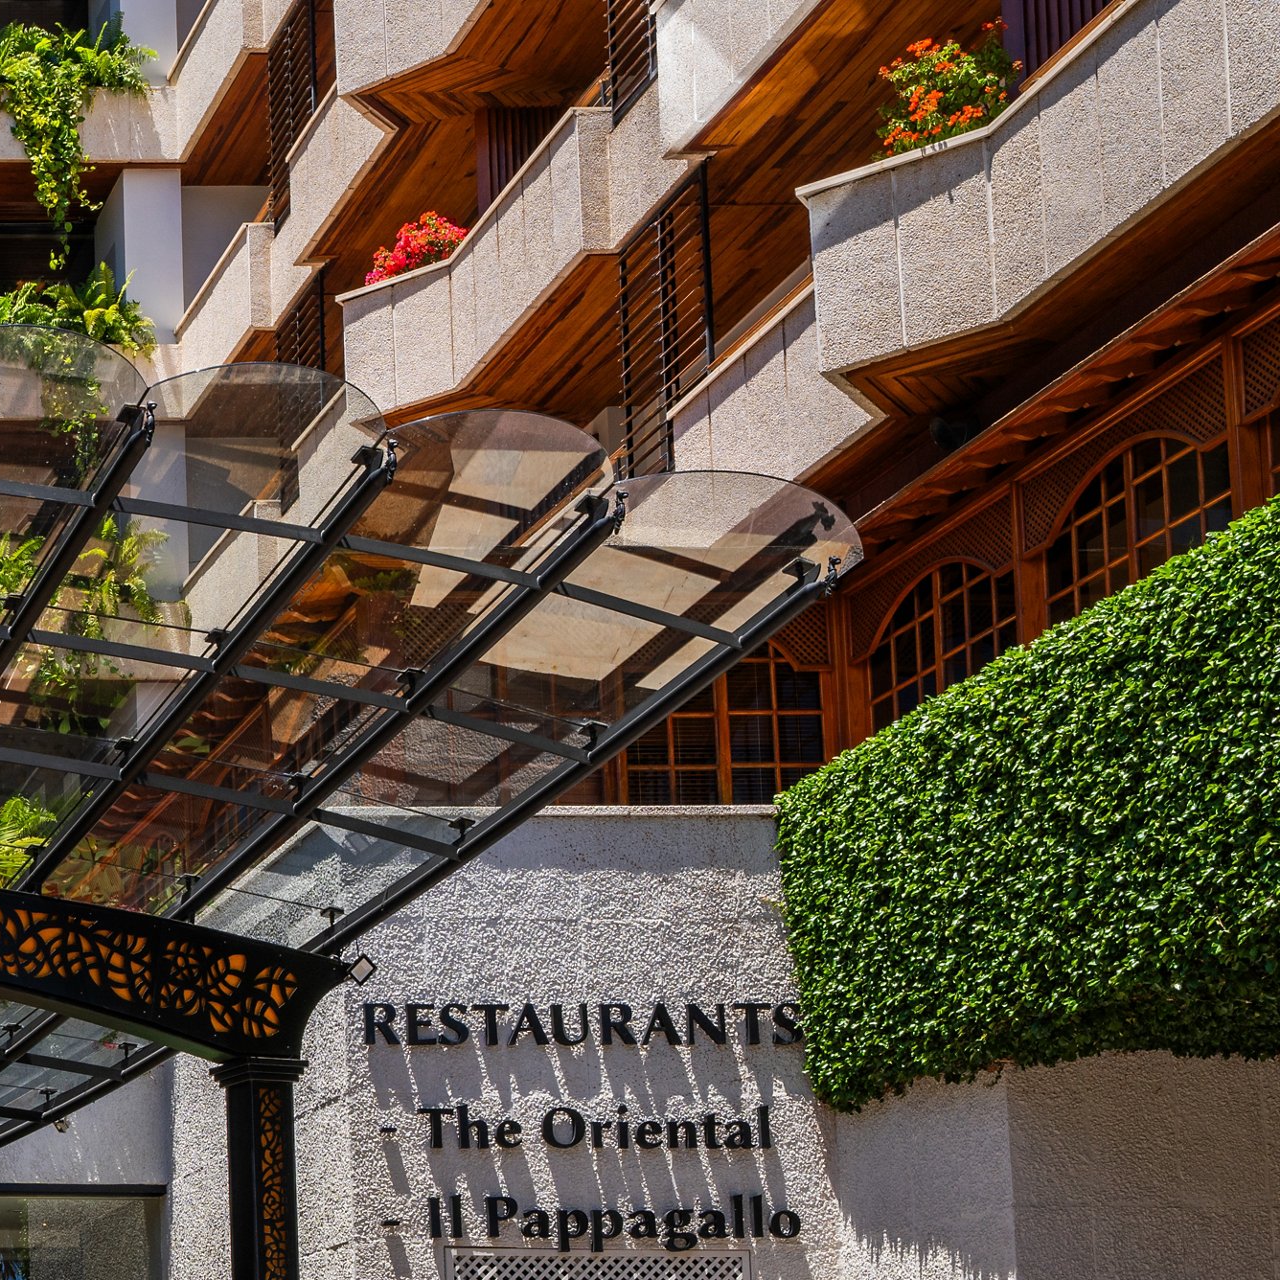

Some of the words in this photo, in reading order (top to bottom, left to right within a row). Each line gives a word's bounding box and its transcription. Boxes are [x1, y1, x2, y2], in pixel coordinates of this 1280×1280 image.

[362, 1002, 803, 1046] RESTAURANTS
[417, 1104, 522, 1149] The
[542, 1104, 772, 1149] Oriental
[429, 1195, 462, 1239] Il
[487, 1195, 801, 1252] Pappagallo
